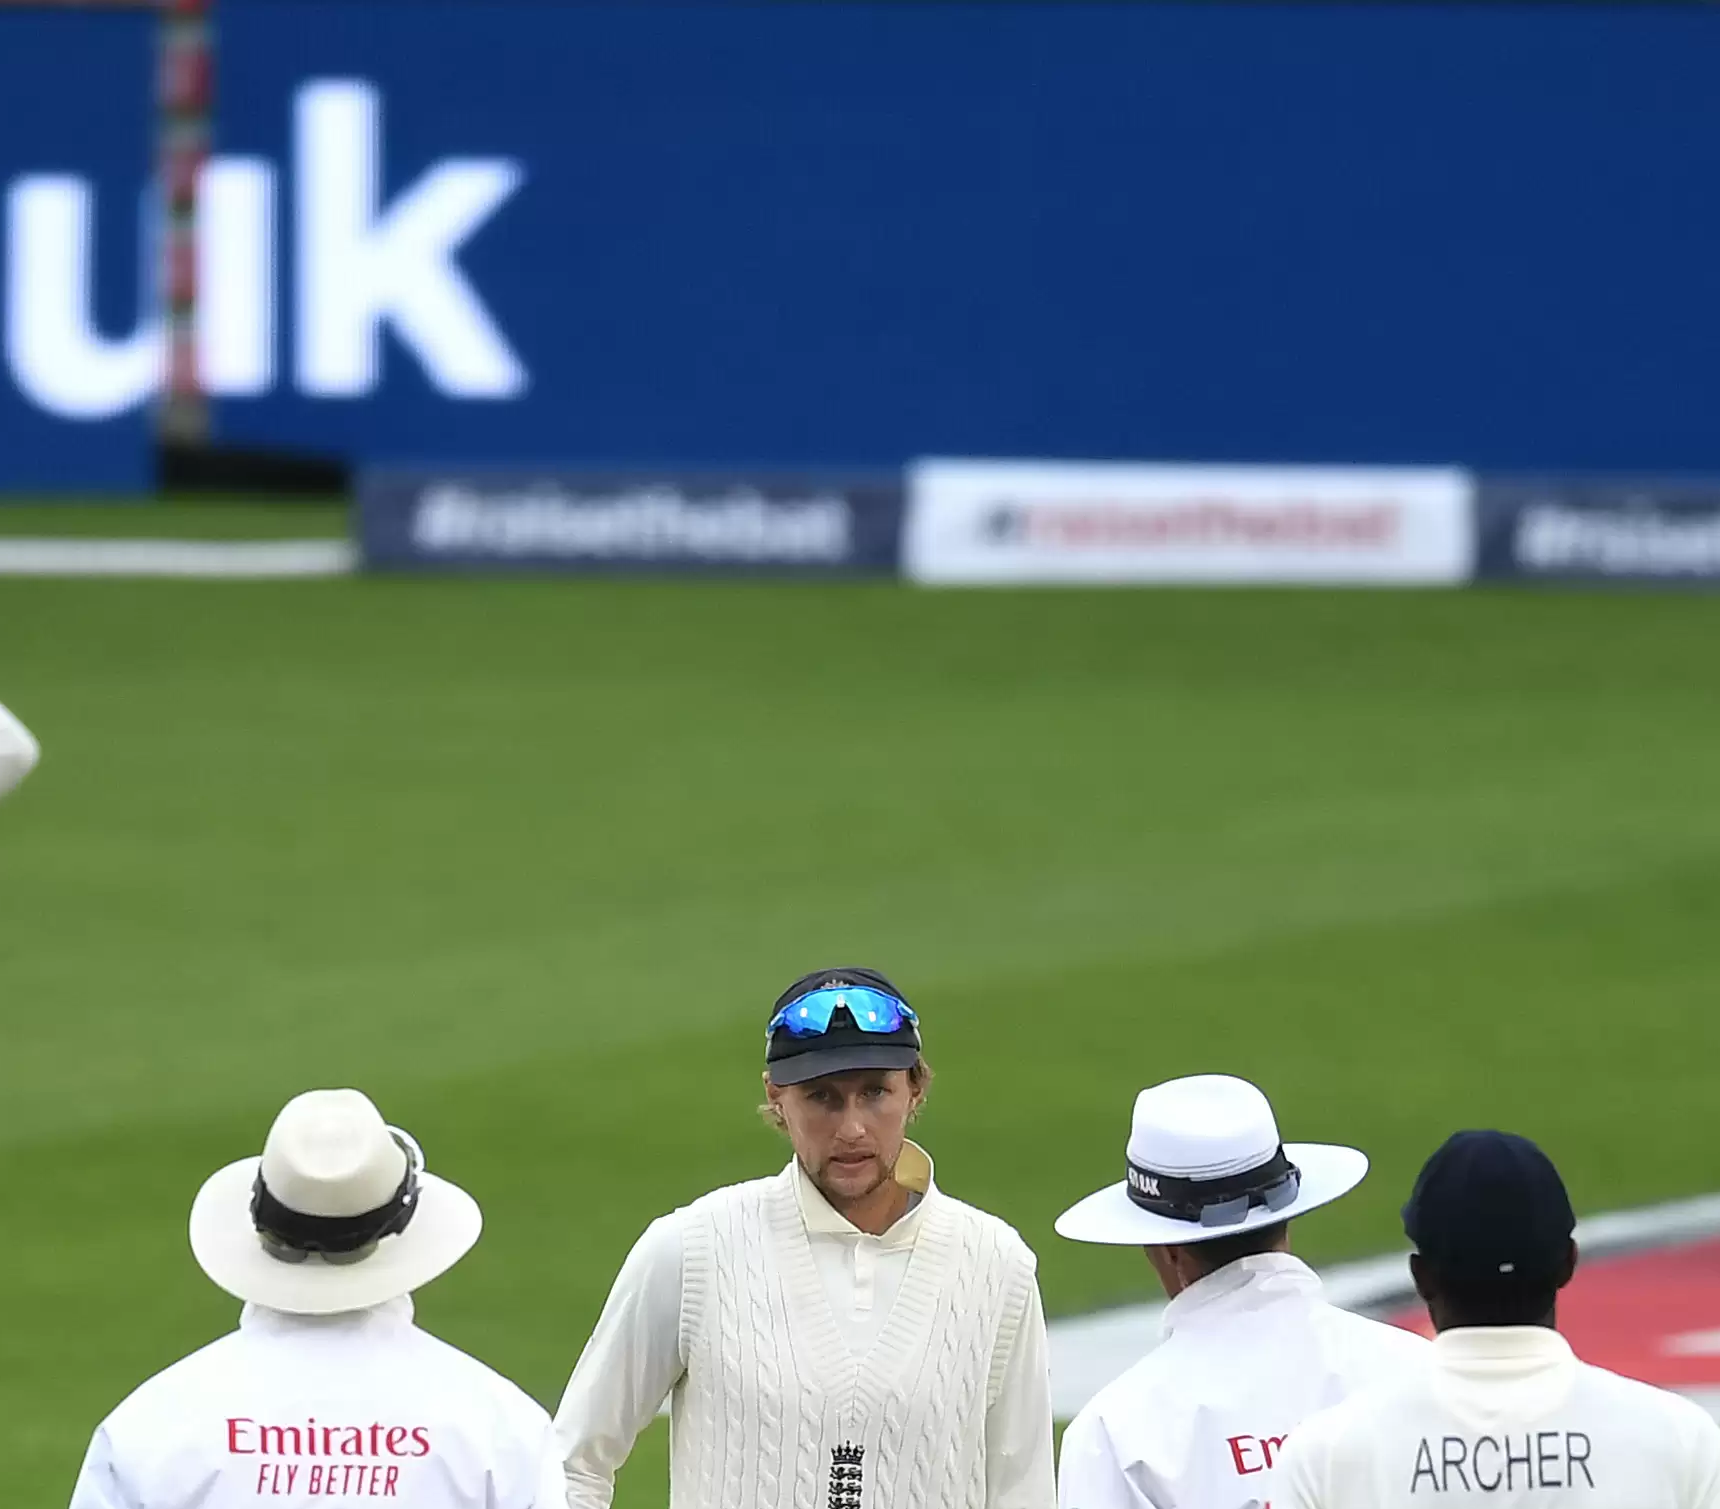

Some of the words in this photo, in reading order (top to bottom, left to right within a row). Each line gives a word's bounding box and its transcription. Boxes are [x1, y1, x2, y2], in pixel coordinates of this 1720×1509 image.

[225, 1418, 430, 1457] Emirates
[256, 1463, 298, 1495] FLY
[308, 1464, 399, 1496] BETTER
[1411, 1431, 1595, 1493] ARCHER
